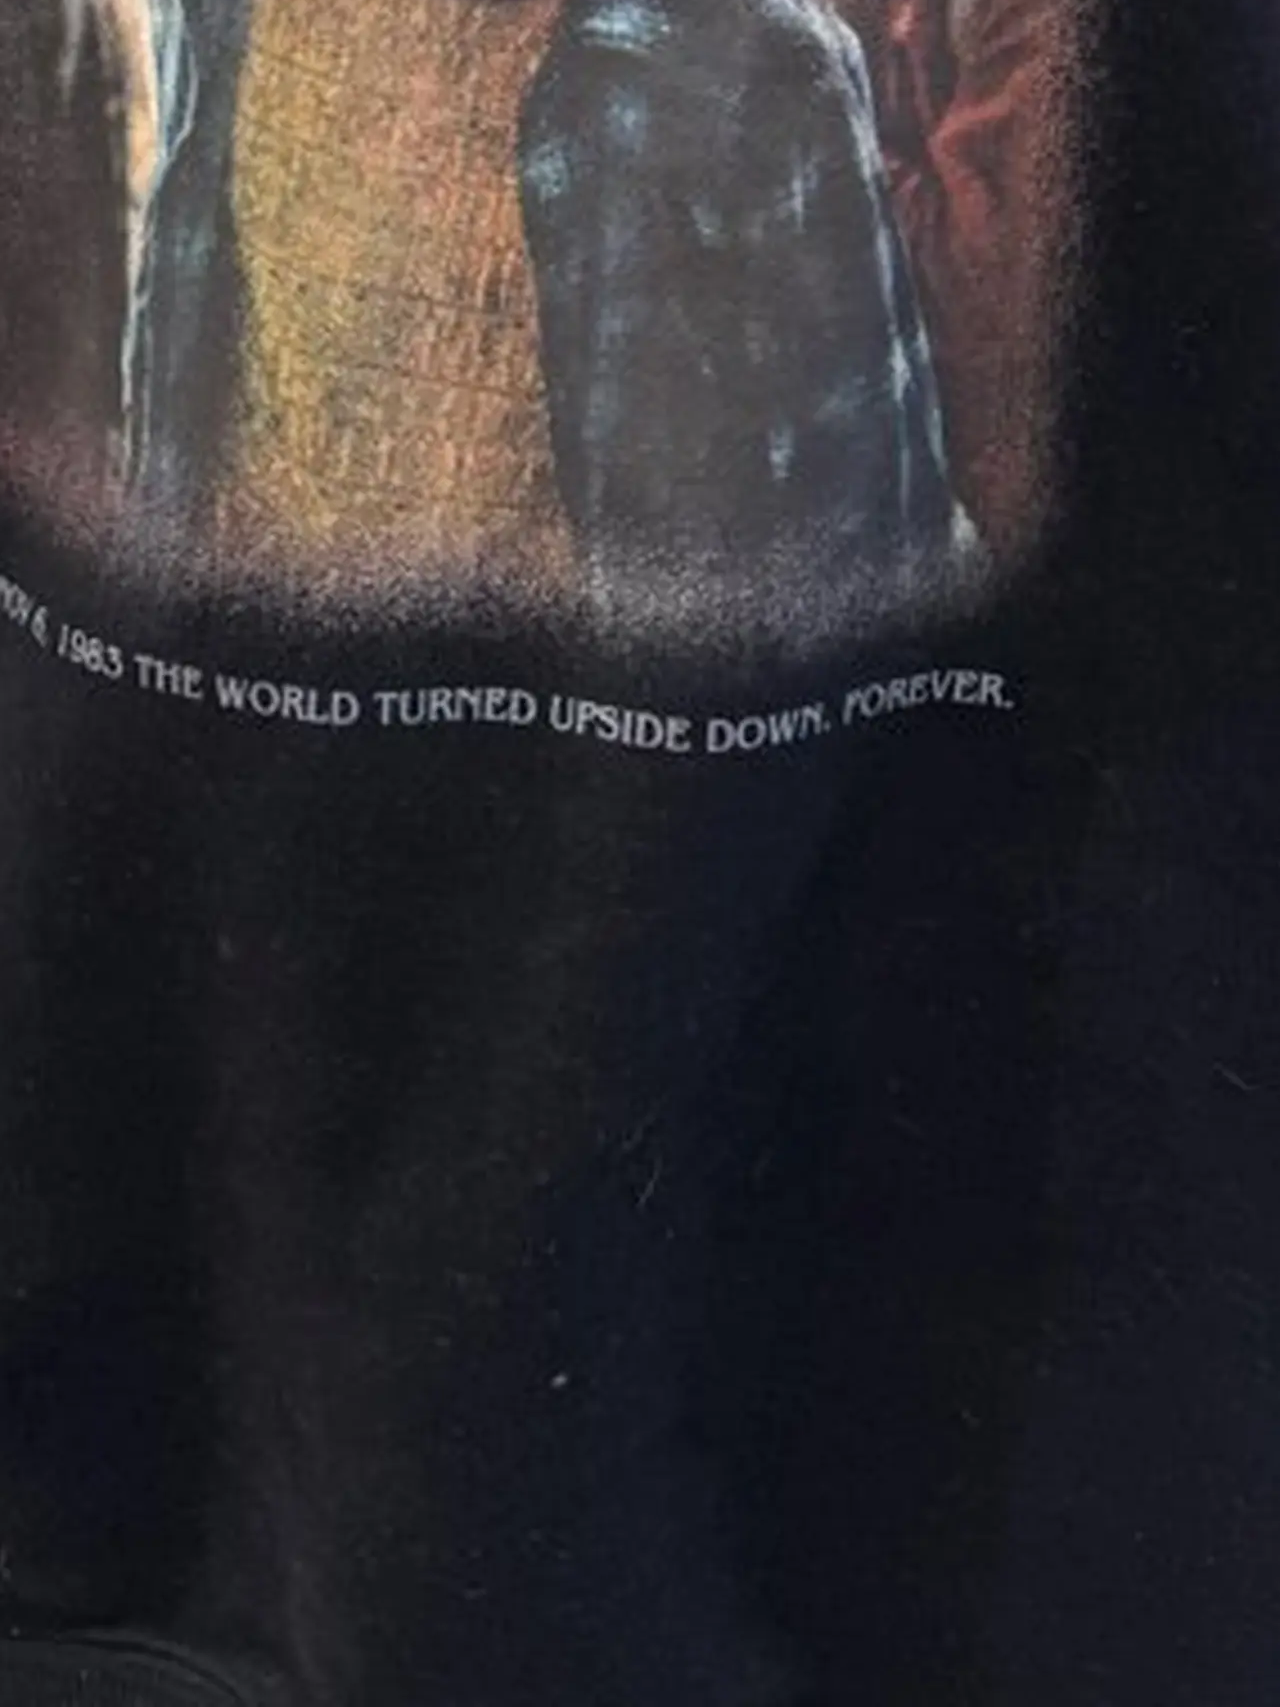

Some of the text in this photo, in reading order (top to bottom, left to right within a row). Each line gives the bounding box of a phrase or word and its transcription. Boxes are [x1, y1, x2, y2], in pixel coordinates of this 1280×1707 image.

[57, 623, 124, 680] 1983
[133, 652, 203, 700] THE
[214, 671, 360, 726] WORLD
[373, 686, 537, 726] TURNED
[549, 693, 692, 753] UPSIDE
